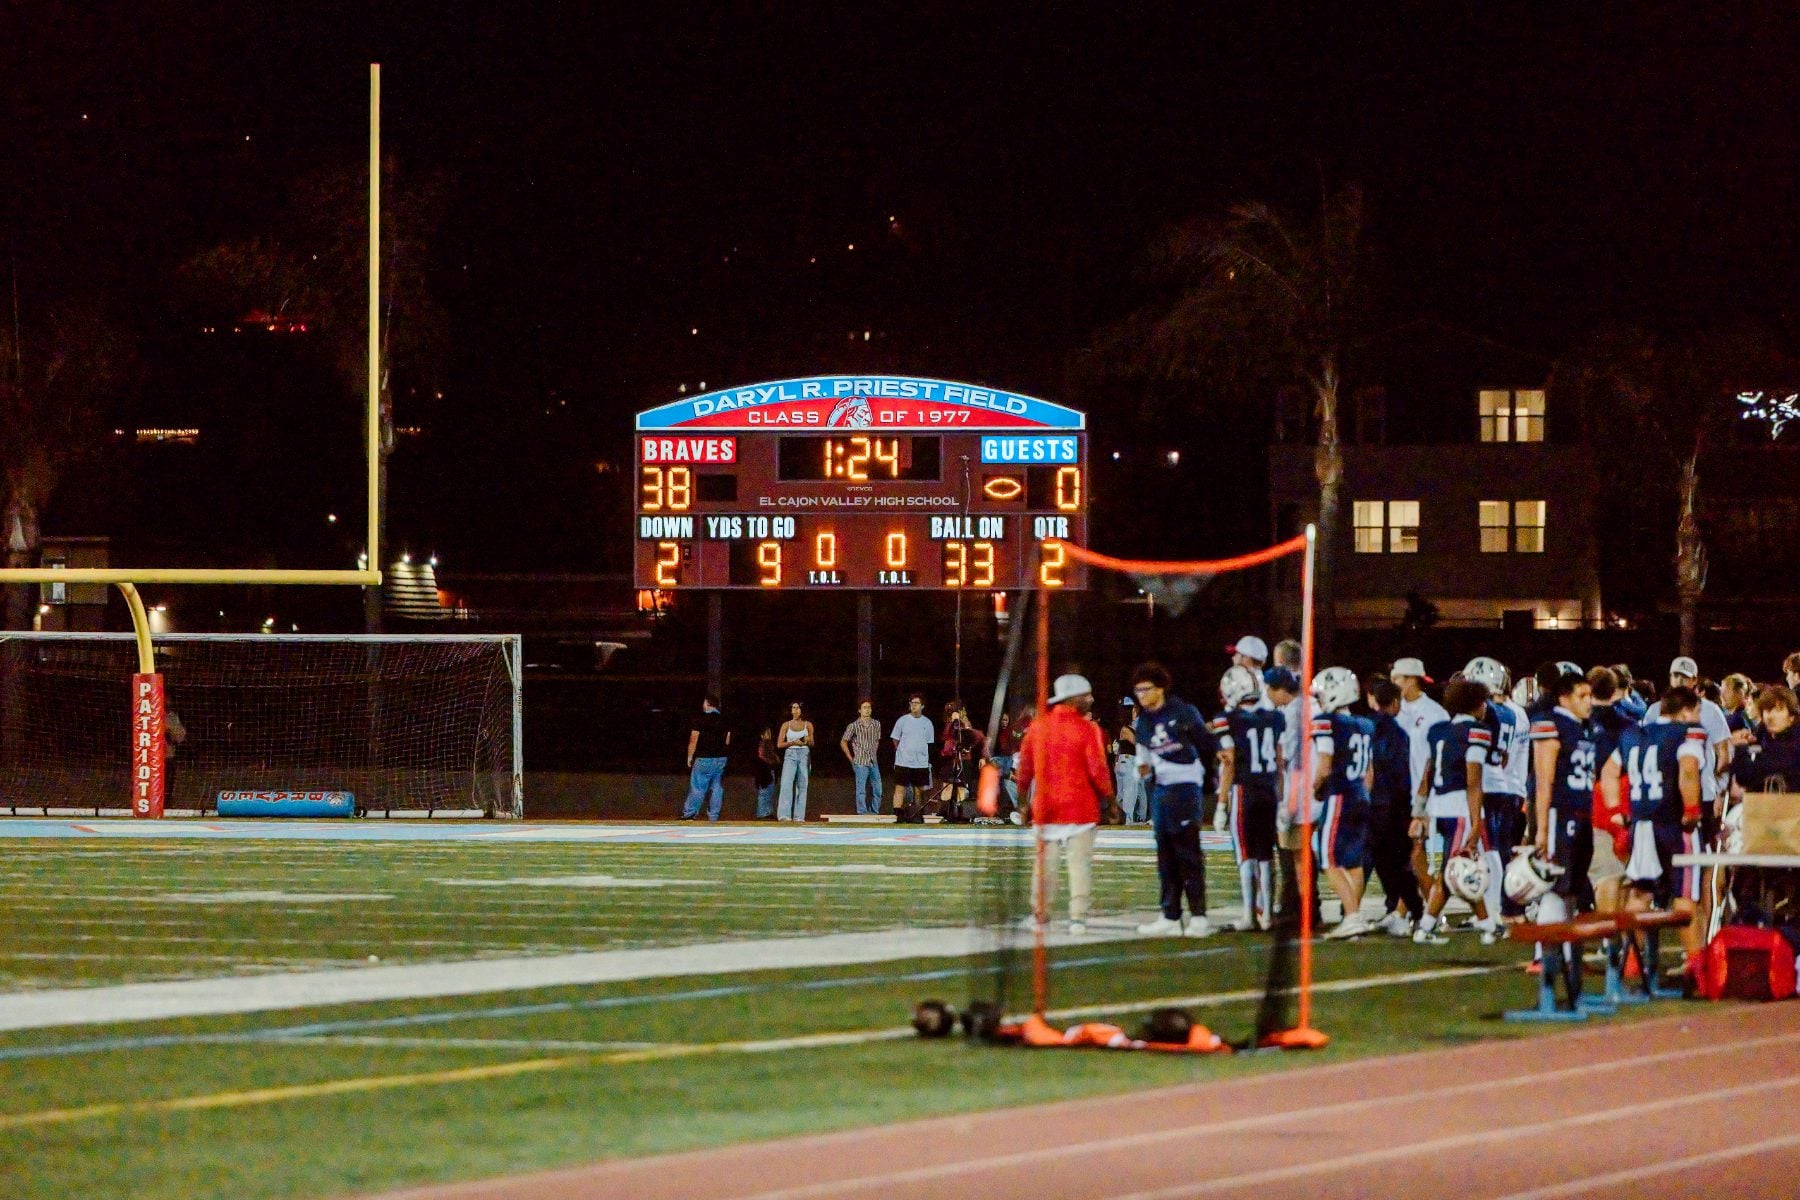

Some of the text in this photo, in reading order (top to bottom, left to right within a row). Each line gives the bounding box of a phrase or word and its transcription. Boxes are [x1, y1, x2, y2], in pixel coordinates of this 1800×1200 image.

[693, 380, 1028, 417] DARYL R. PRIEST FIELD
[748, 411, 819, 423] CLASS
[880, 411, 971, 423] OF 1977
[644, 439, 733, 461] BRAVES
[823, 437, 898, 479] 1:24
[984, 439, 1075, 461] GUESTS
[642, 467, 691, 510] 38
[759, 497, 960, 508] EL CAJON VALLEY HIGH SCHOOL
[1057, 467, 1080, 509] 0
[641, 517, 693, 538] DOWN
[707, 517, 795, 538] YDS TO GO
[979, 517, 1003, 539] ON
[1034, 517, 1069, 540] QTR
[657, 542, 679, 585] 2
[758, 542, 782, 585] 9
[816, 533, 836, 566] 0
[887, 533, 907, 566] 0
[945, 542, 994, 586] 33
[1040, 542, 1065, 586] 2
[139, 682, 152, 813] PATRIOTS
[1246, 727, 1277, 773] 14
[1627, 744, 1664, 801] 44
[221, 791, 324, 803] BRAVES
